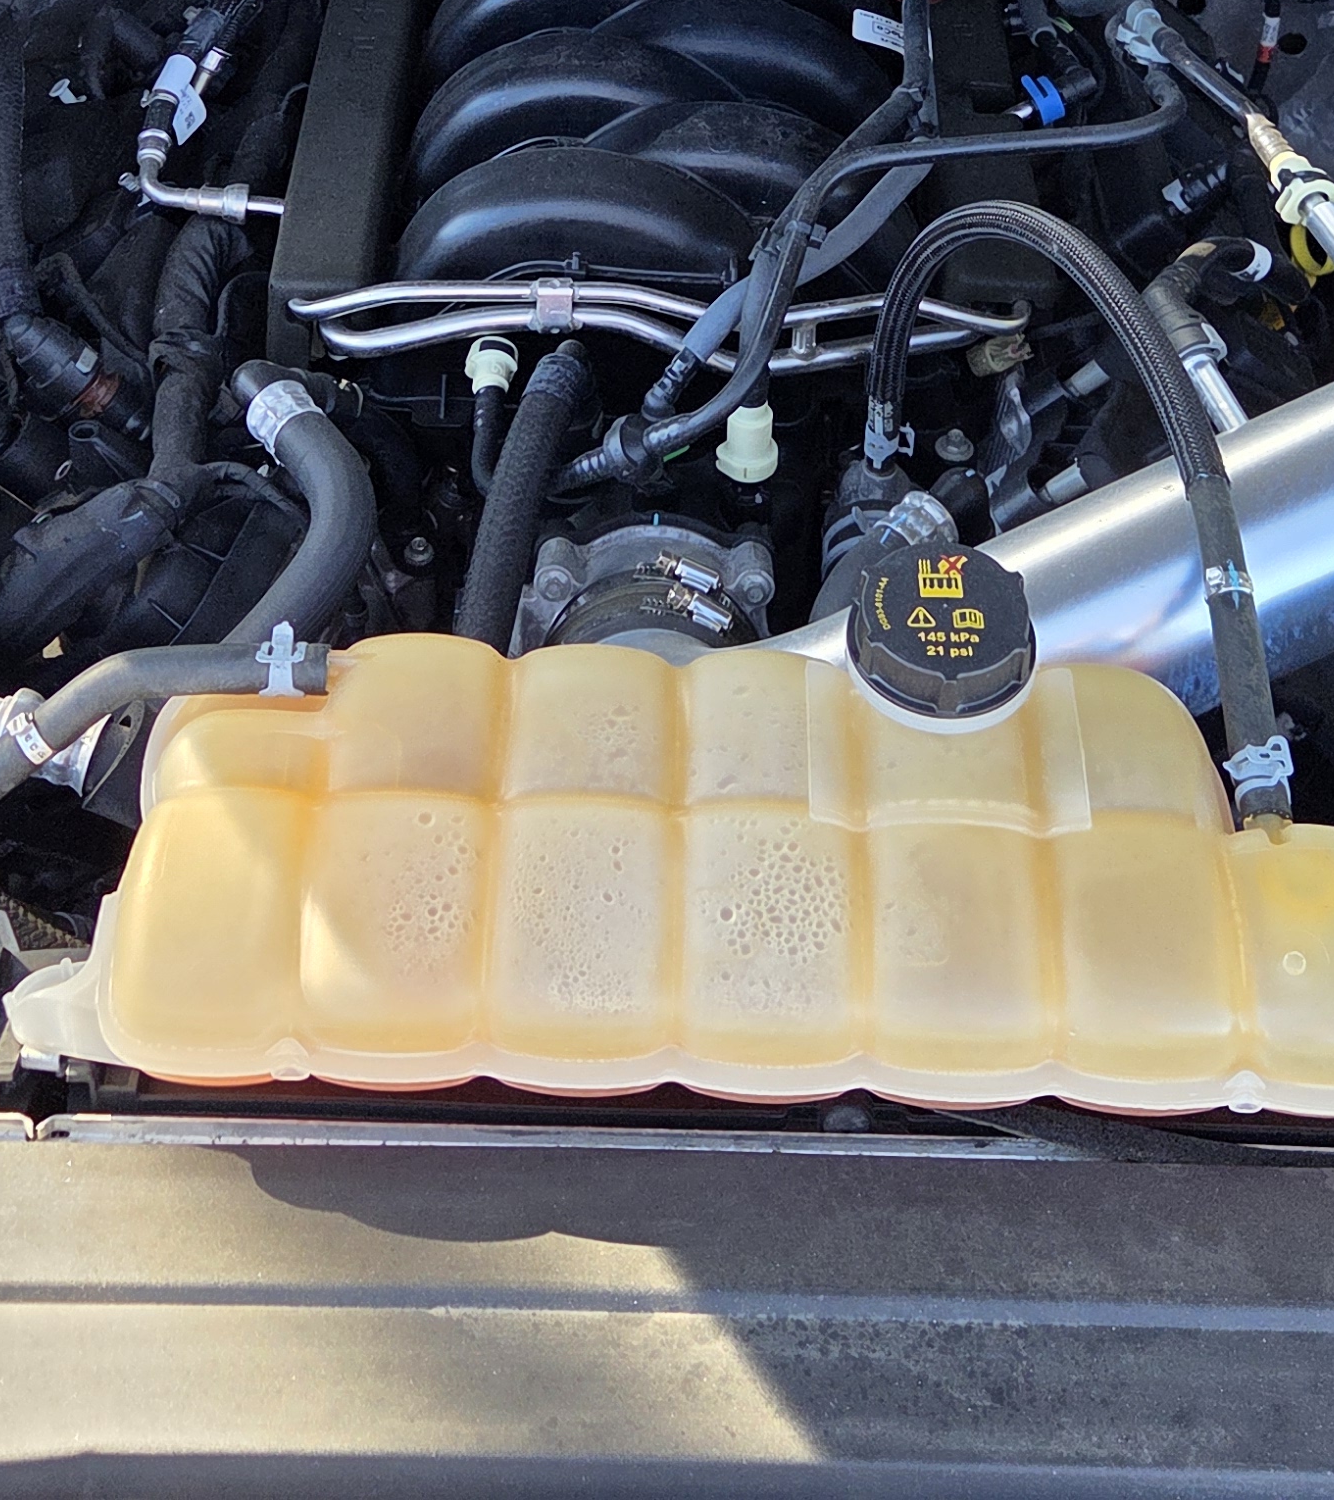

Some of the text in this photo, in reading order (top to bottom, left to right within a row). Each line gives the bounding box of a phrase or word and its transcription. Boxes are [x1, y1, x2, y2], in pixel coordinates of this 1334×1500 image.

[918, 631, 980, 644] 145 kPa
[926, 644, 974, 658] 21 psi
